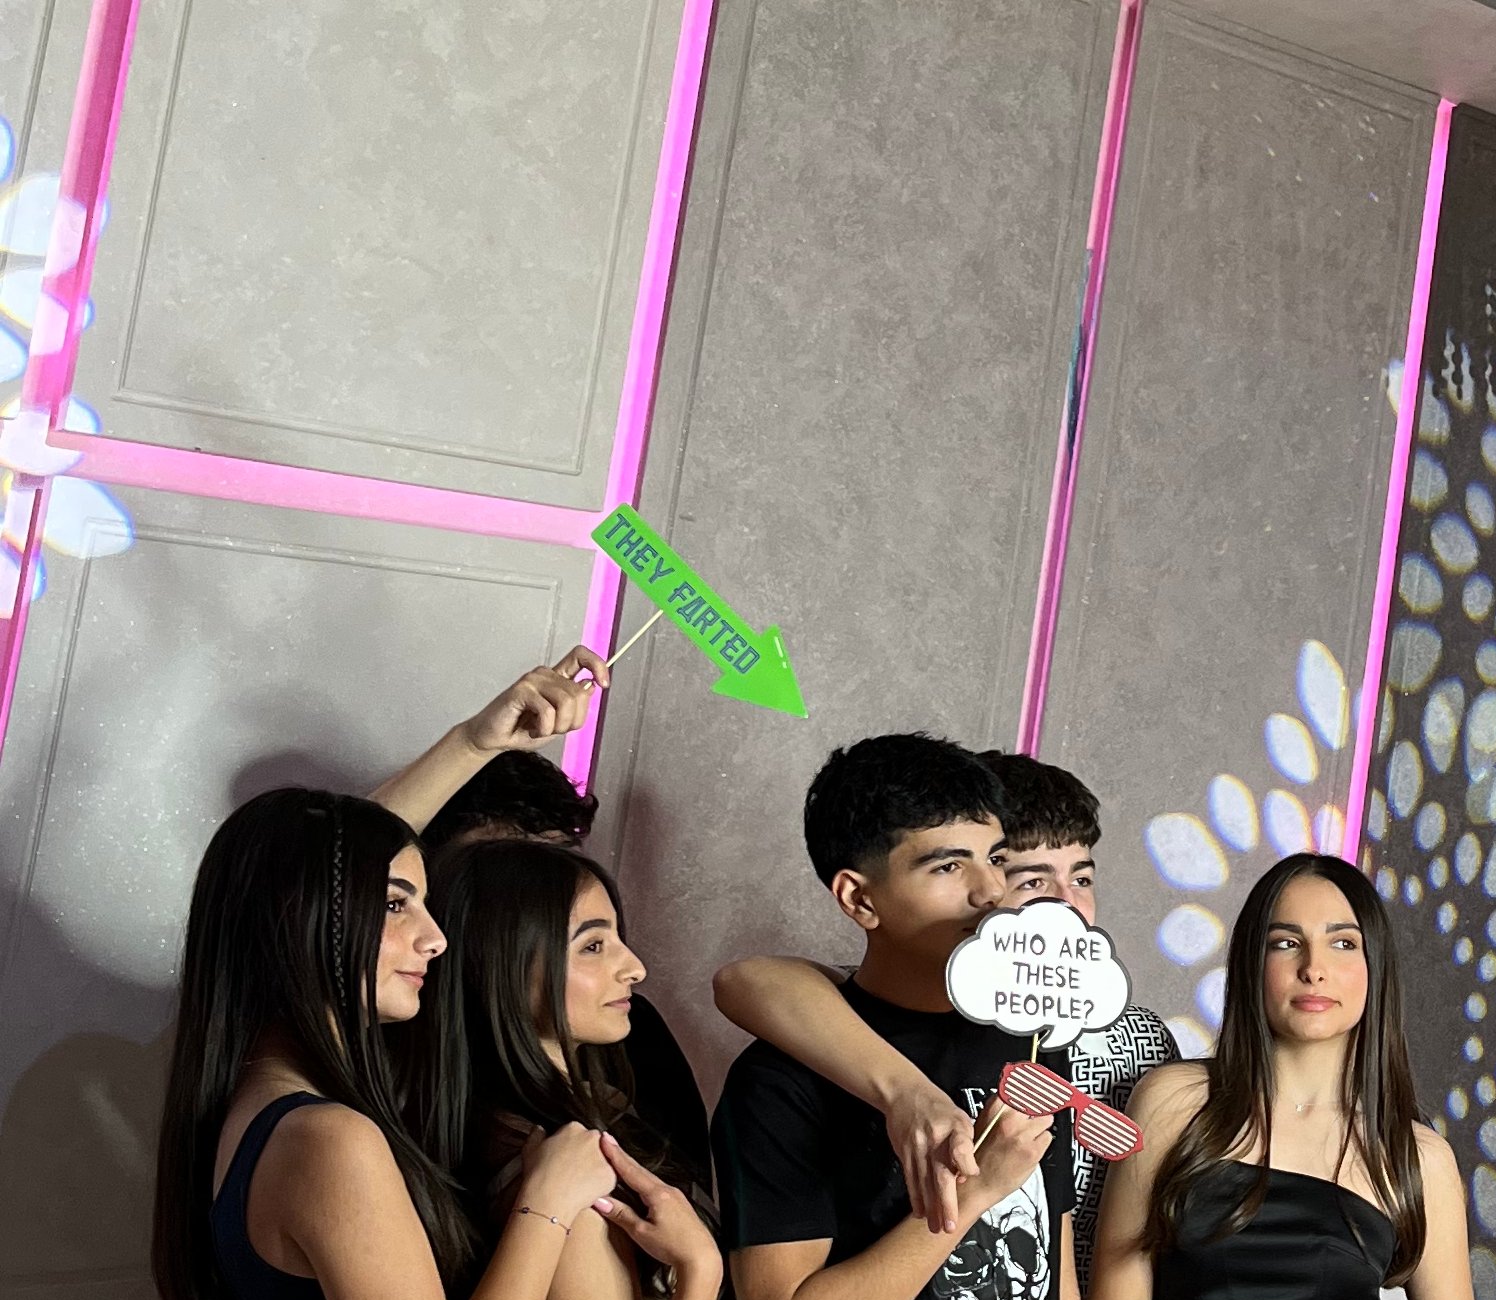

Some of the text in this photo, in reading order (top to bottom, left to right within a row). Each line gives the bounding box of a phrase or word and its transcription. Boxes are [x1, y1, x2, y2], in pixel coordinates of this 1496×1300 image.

[604, 513, 761, 675] THEY FARTED
[993, 932, 1102, 961] WHO ARE
[1012, 961, 1081, 989] THESE
[994, 991, 1095, 1025] PEOPLE?
